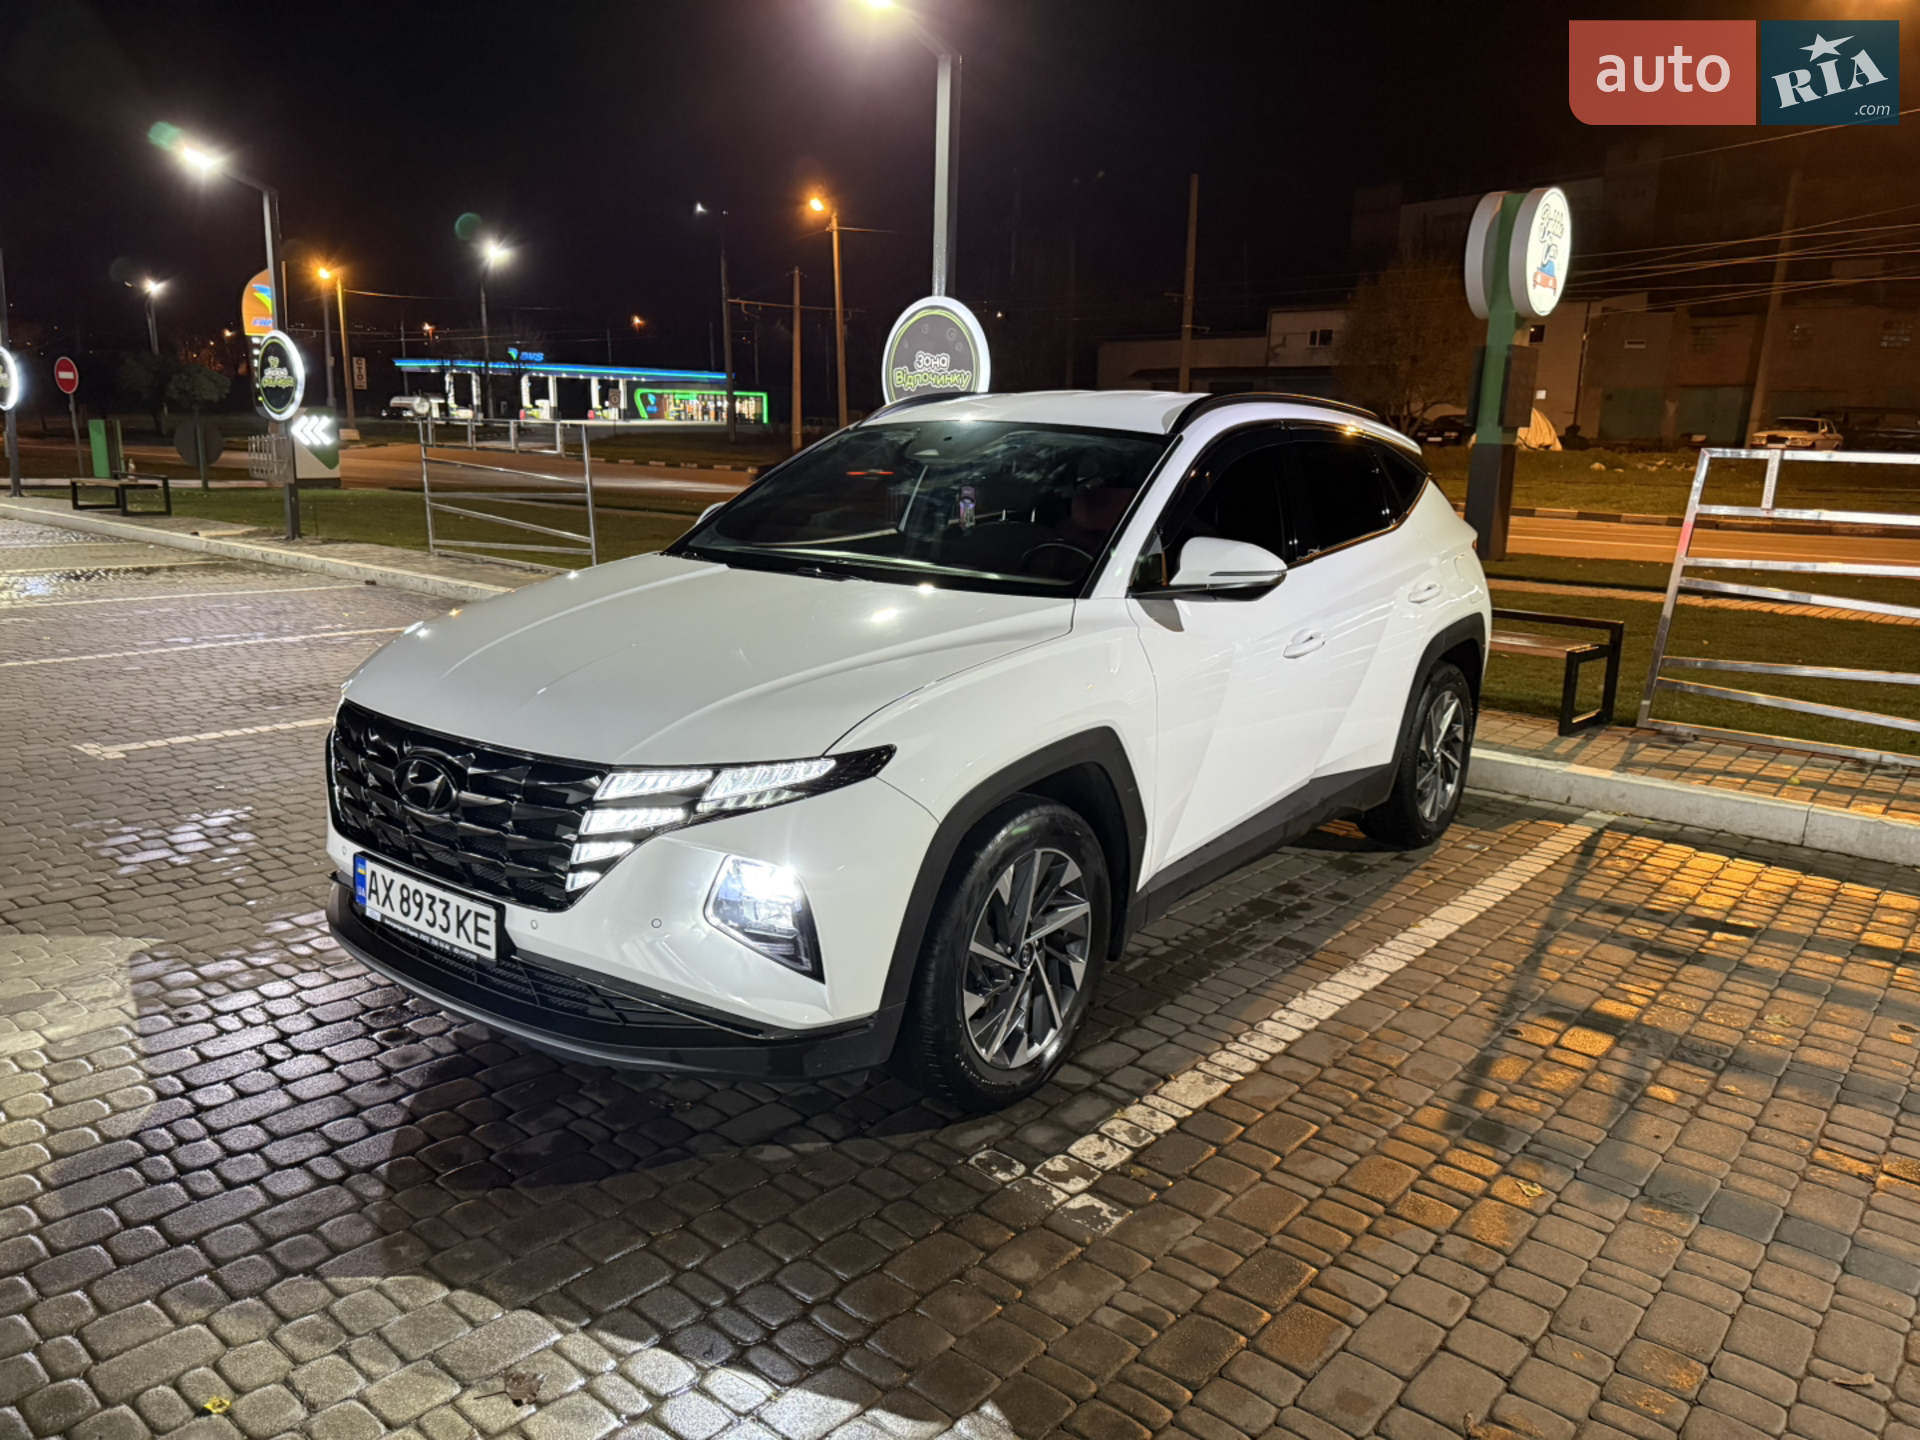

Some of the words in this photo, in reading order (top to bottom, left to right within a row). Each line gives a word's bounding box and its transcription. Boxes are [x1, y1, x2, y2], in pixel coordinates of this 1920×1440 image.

[914, 353, 950, 370] Зона
[894, 367, 971, 391] Відпочинку
[357, 885, 366, 898] UA
[368, 869, 395, 913] AX
[399, 883, 451, 935] 8933
[455, 903, 492, 952] KE
